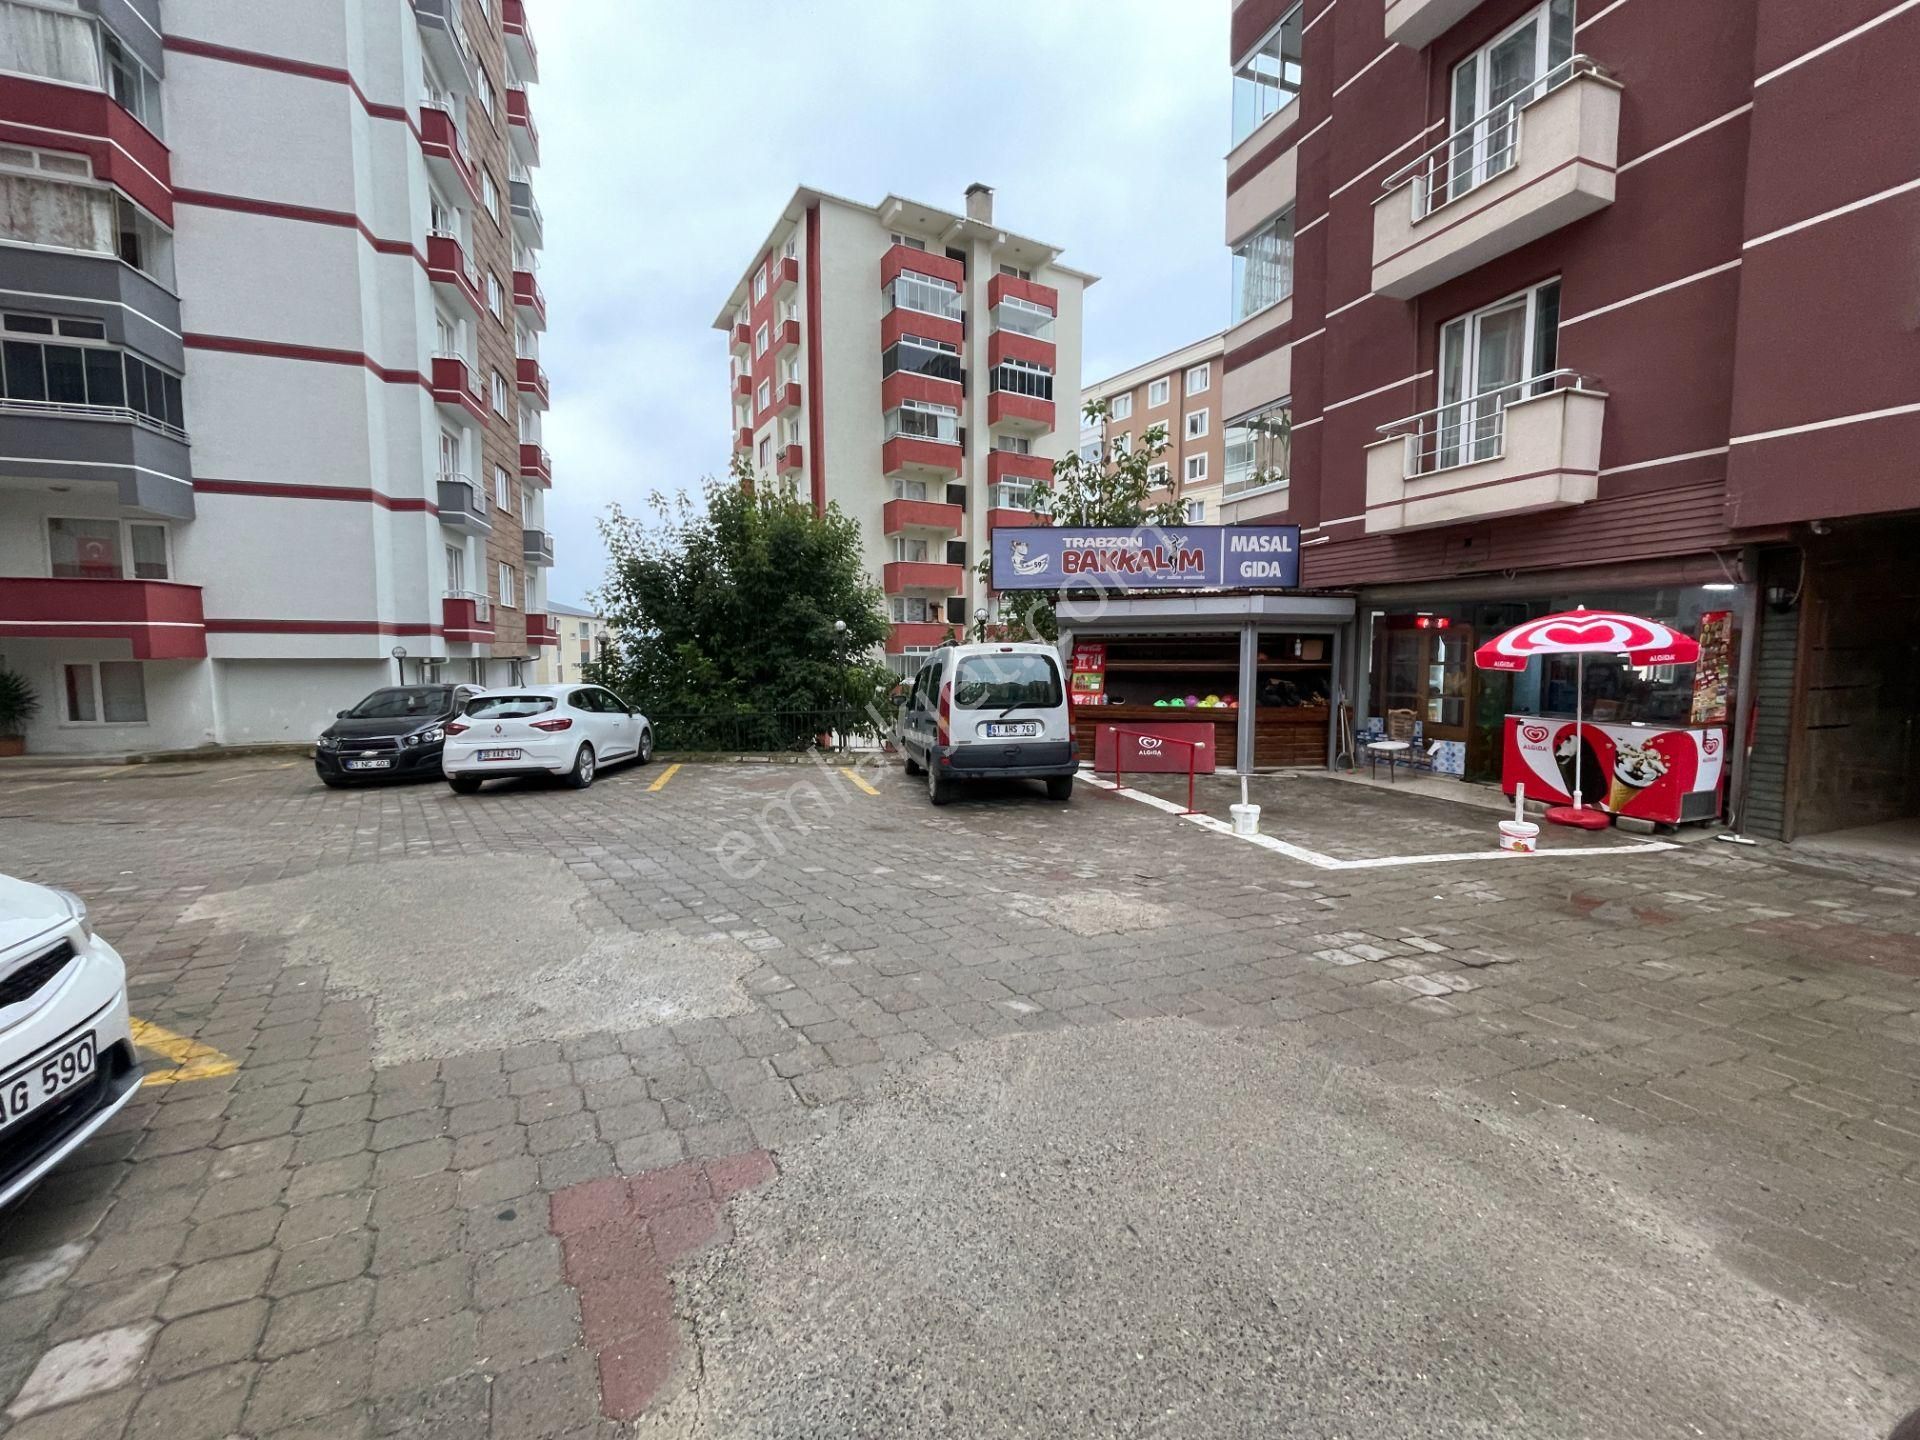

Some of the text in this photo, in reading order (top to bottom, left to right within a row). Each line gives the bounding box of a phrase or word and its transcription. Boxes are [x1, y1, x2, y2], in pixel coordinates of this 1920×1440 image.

[1062, 537, 1142, 548] TRABZON
[1230, 535, 1292, 552] MASAL
[1240, 561, 1282, 577] GIDA
[42, 1041, 93, 1096] 590
